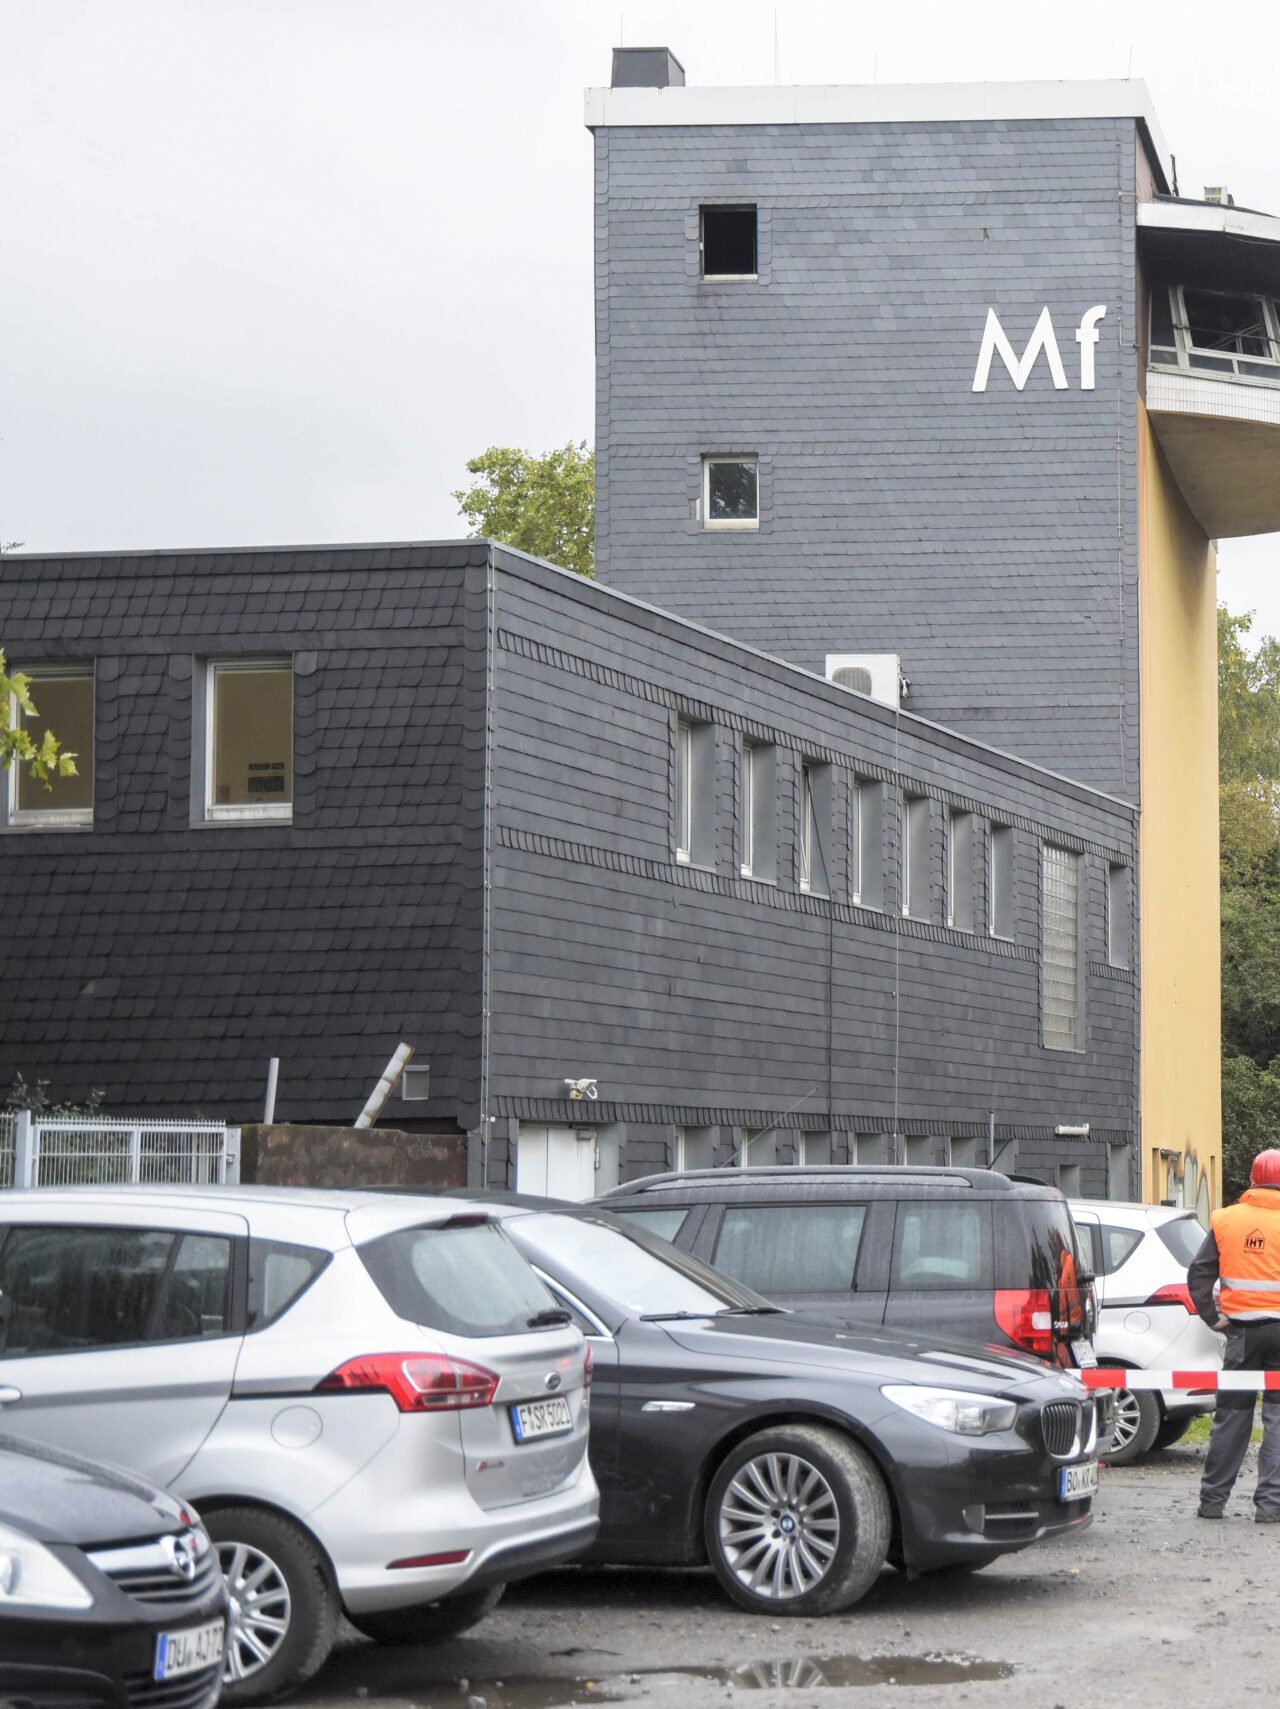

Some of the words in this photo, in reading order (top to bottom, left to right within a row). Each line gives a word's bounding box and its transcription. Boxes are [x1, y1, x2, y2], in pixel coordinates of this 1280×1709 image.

[971, 304, 1107, 393] Mf
[1246, 1238, 1264, 1248] IHT
[520, 1408, 527, 1433] F
[533, 1404, 548, 1430] SR
[1067, 1470, 1078, 1491] BO
